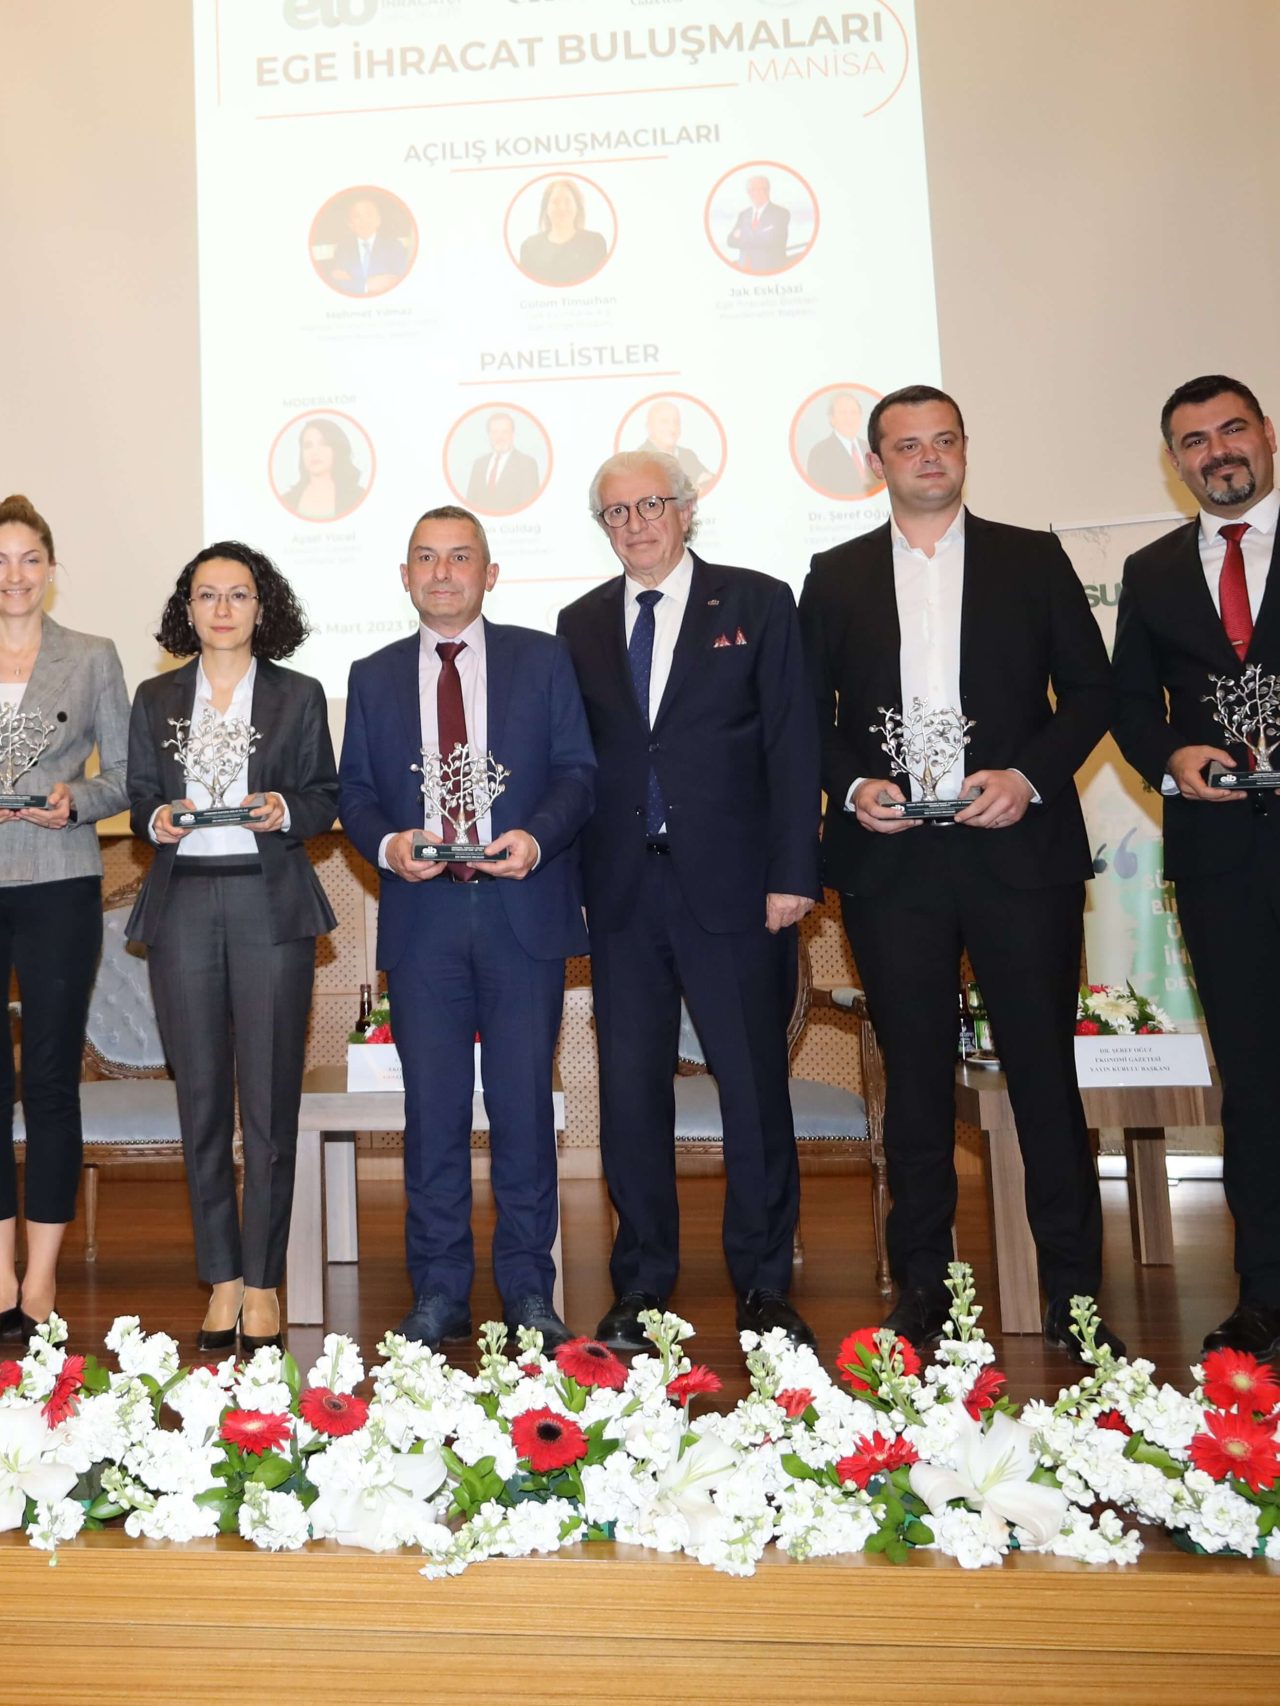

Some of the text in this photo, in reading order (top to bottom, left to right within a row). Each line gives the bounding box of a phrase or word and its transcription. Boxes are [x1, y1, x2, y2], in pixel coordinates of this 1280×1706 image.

[255, 12, 883, 87] EGE İHRACAT BULUŞMALARI
[748, 49, 885, 83] MANİSA
[403, 123, 721, 167] AÇILIŞ KONUŞMACILARI
[480, 343, 660, 371] PANELİSTLER
[1084, 583, 1120, 608] SU
